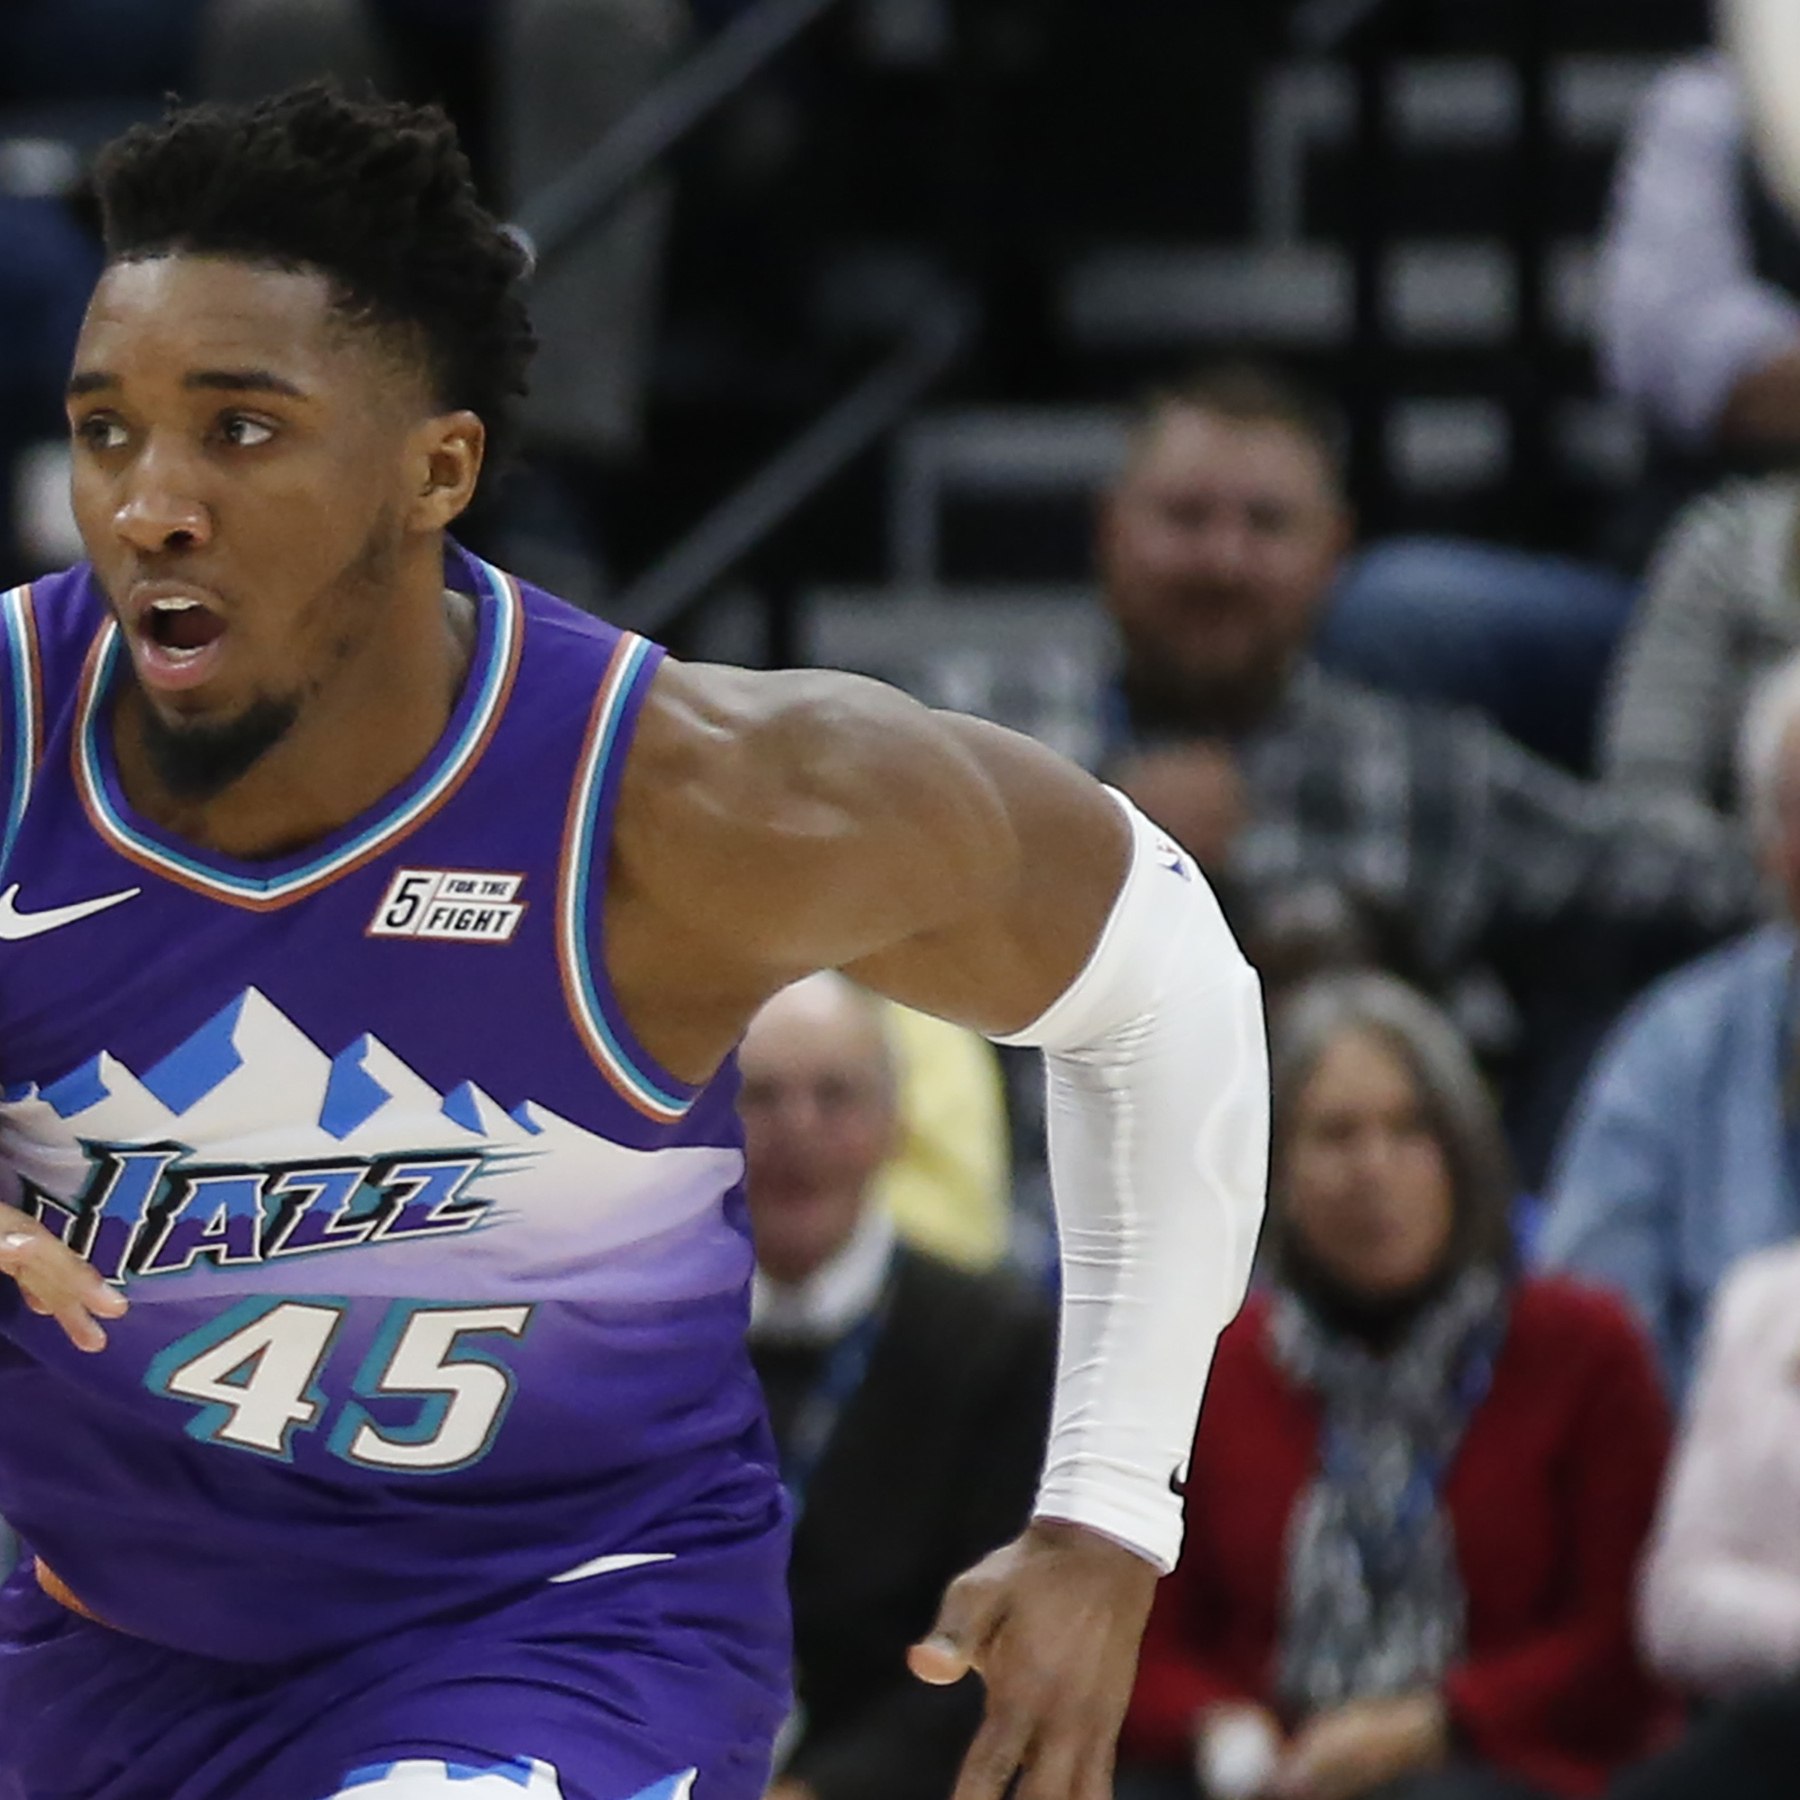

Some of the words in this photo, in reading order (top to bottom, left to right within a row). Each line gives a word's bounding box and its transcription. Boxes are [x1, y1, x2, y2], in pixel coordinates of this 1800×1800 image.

[385, 877, 431, 928] 5
[446, 879, 477, 894] FOR
[480, 881, 509, 895] THE
[429, 907, 513, 932] FIGHT
[152, 1299, 536, 1470] 45
